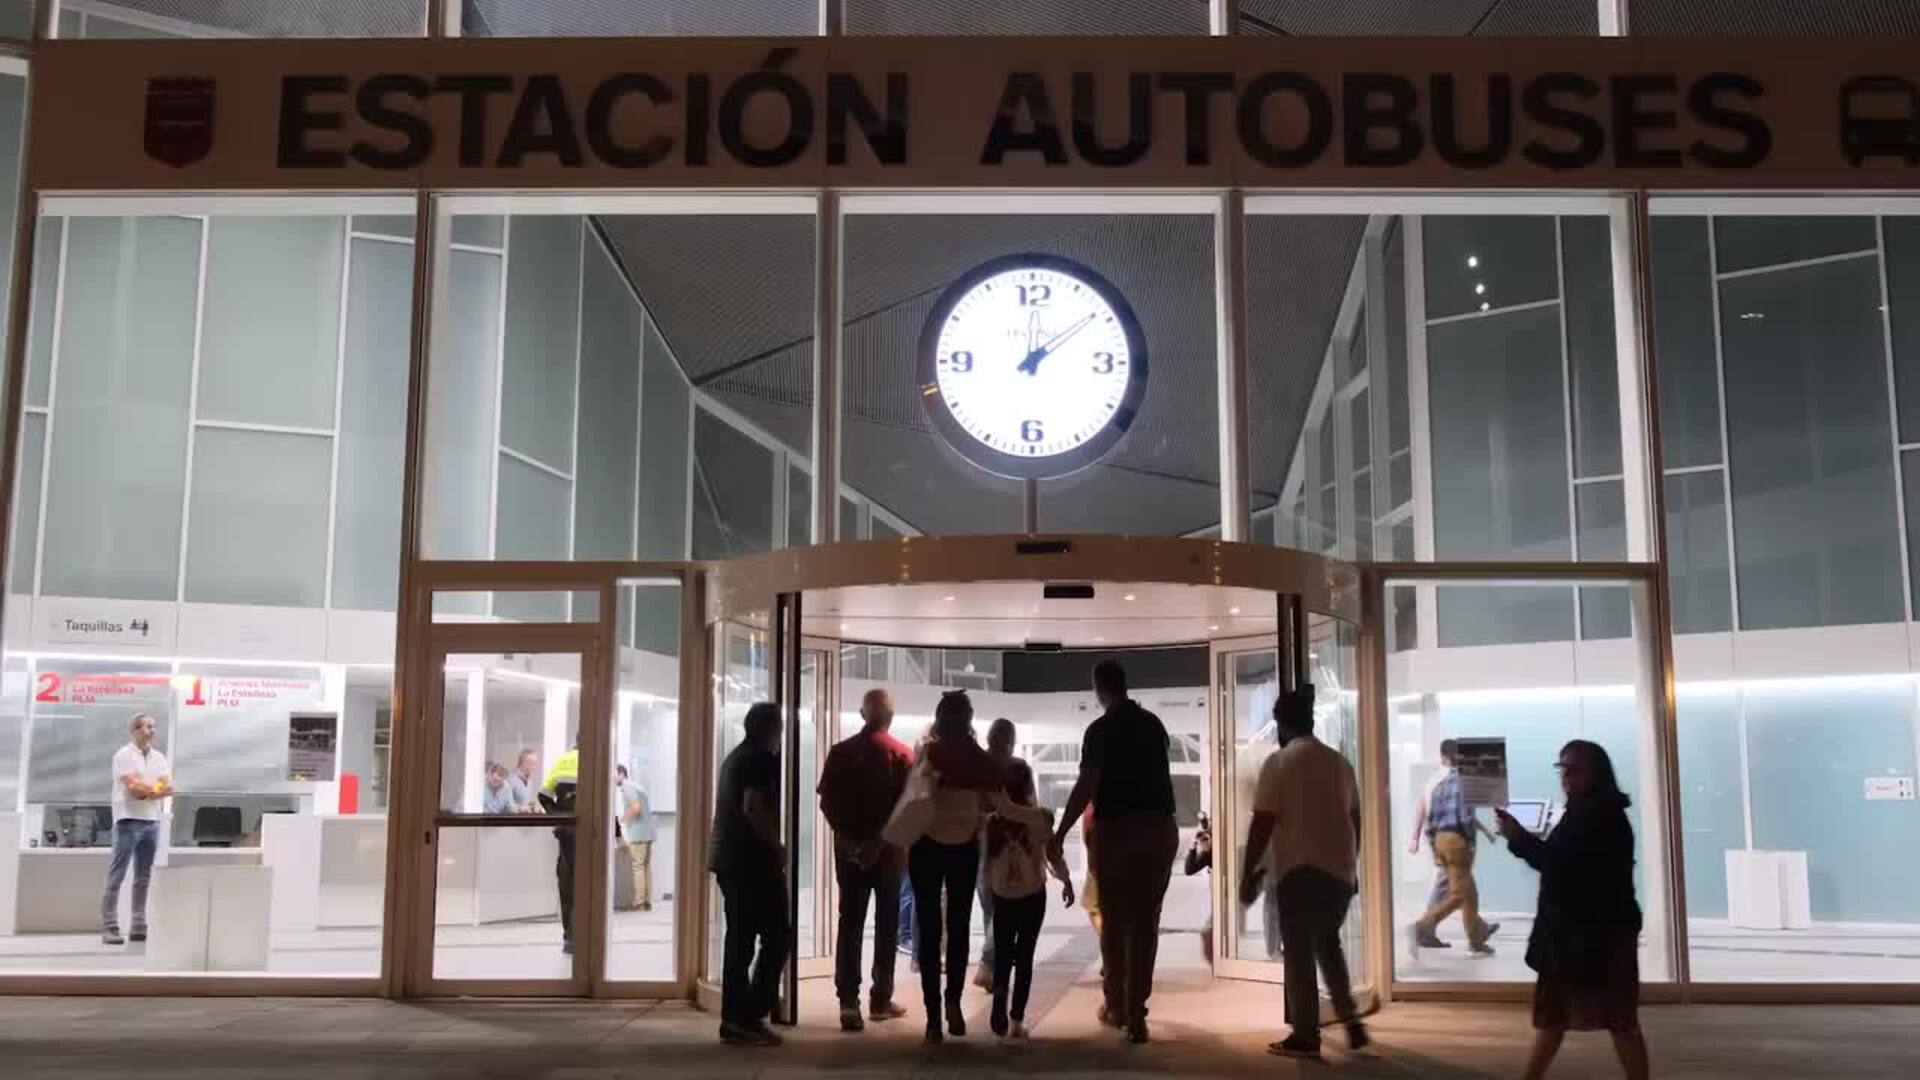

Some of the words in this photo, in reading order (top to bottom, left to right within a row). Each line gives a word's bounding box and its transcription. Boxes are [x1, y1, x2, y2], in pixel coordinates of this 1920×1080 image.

[276, 49, 909, 170] ESTACIÓN
[979, 71, 1774, 170] AUTOBUSES
[1015, 284, 1052, 307] 12
[950, 350, 974, 373] 9
[1092, 351, 1114, 374] 3
[1020, 420, 1044, 442] 6
[65, 619, 123, 634] Taquillas
[35, 671, 61, 702] 2
[184, 676, 206, 706] 1
